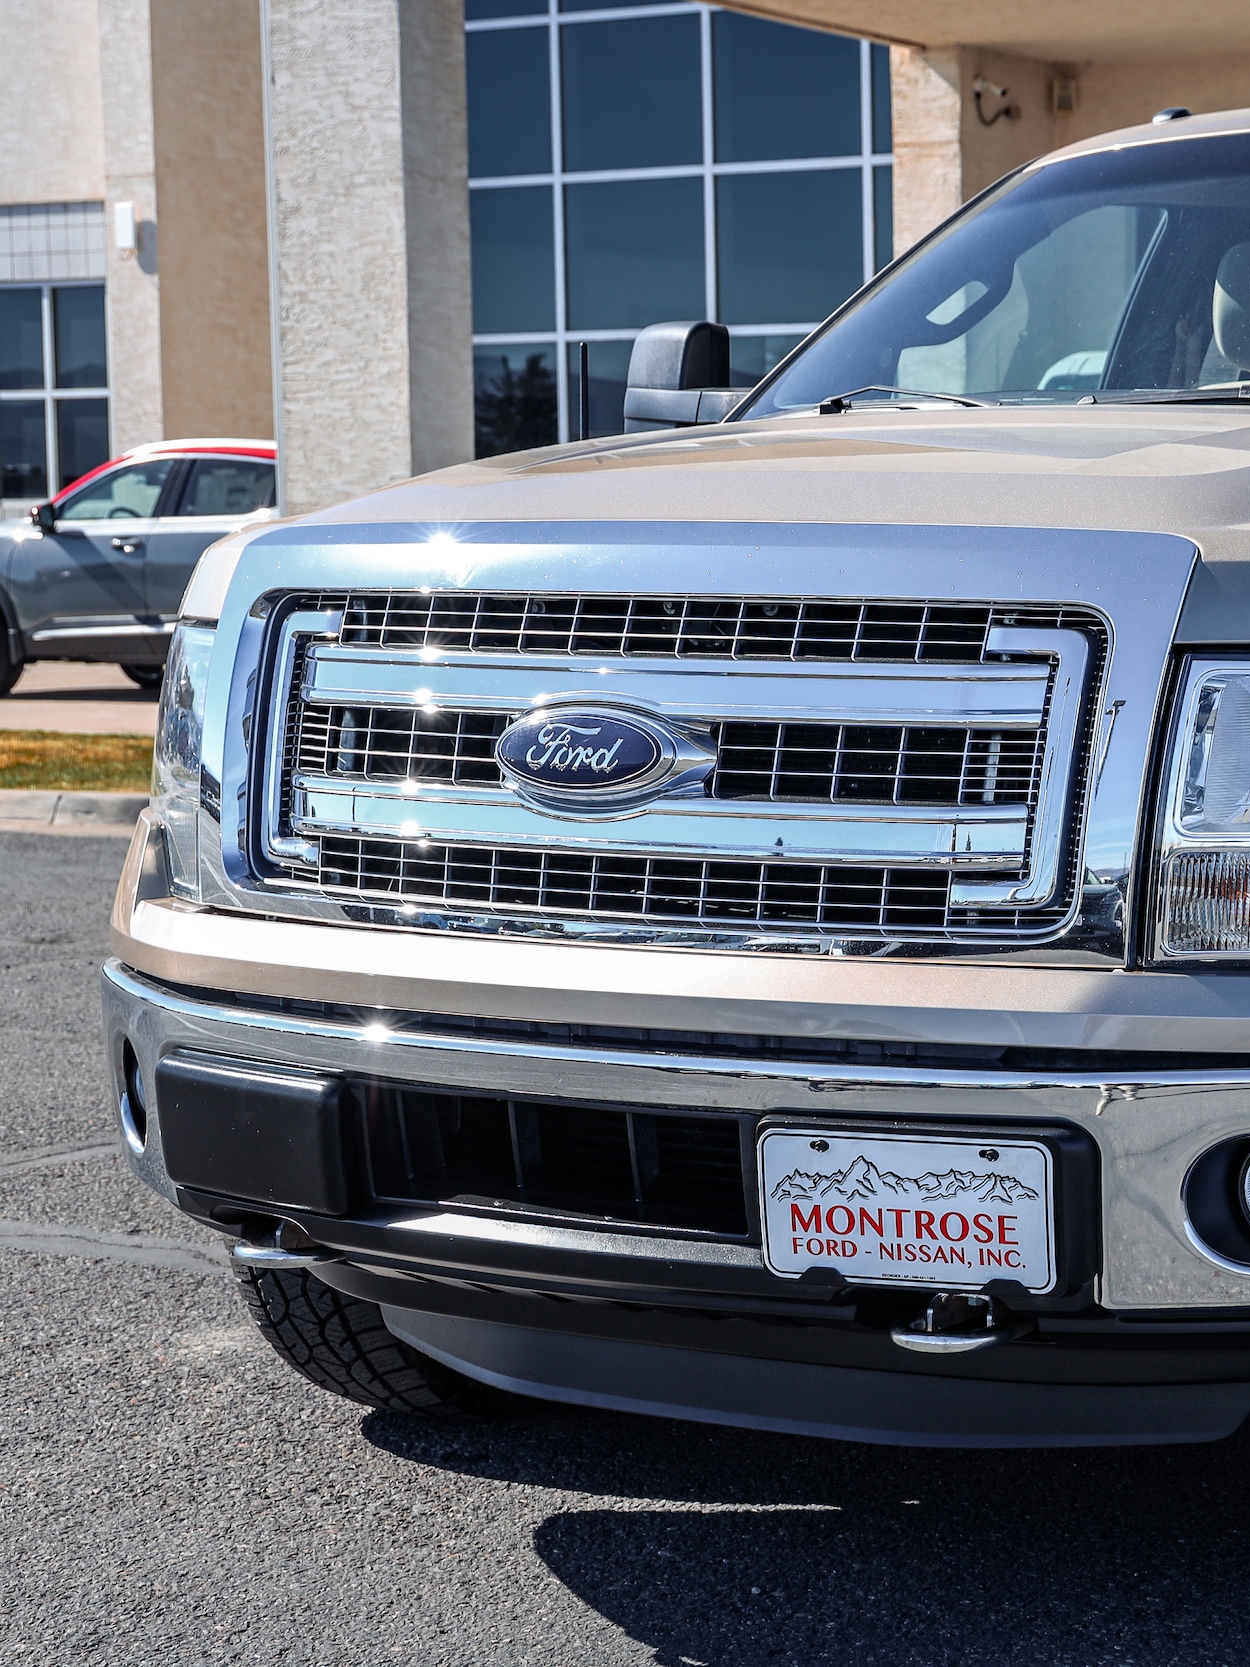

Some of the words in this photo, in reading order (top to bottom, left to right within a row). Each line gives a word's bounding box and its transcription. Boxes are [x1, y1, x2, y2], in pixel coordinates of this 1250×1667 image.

[526, 723, 624, 772] Ford
[790, 1203, 1019, 1245] MONTROSE
[792, 1237, 858, 1258] FORD
[879, 1242, 972, 1269] NISSAN,
[979, 1247, 1026, 1269] INC.
